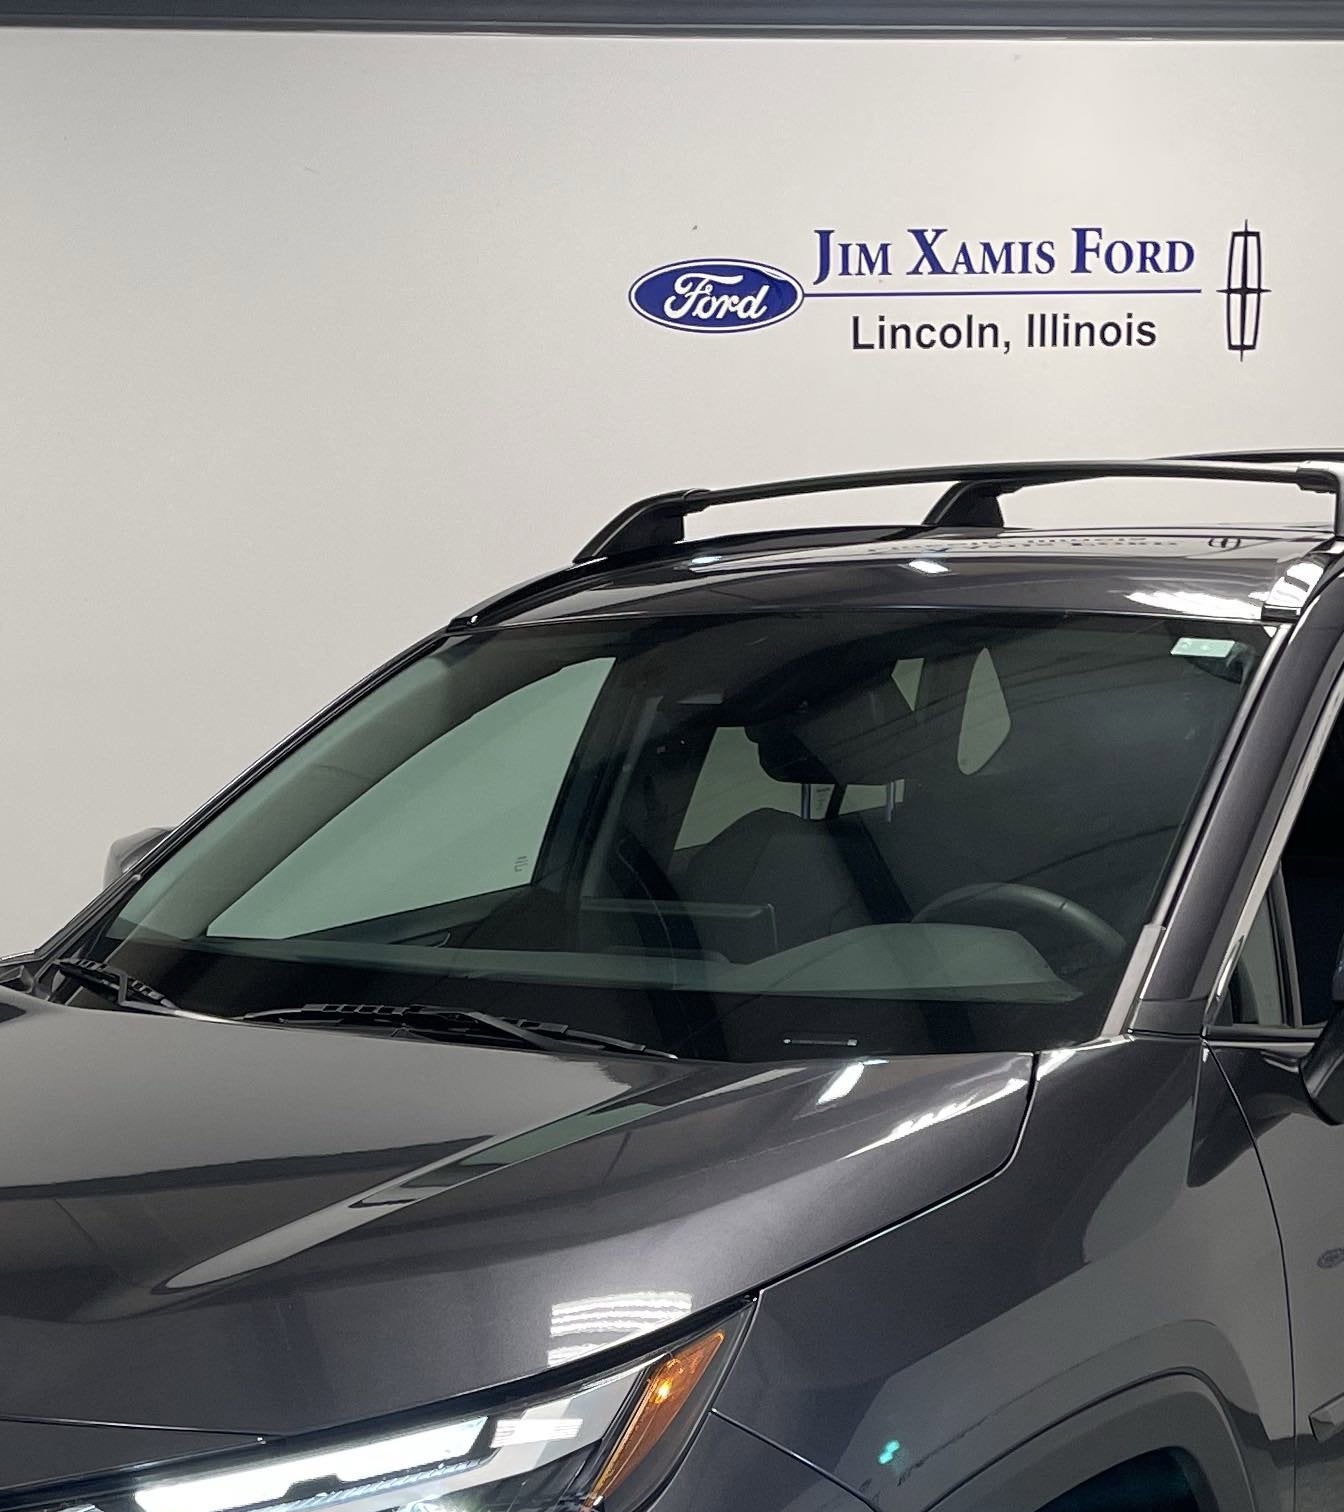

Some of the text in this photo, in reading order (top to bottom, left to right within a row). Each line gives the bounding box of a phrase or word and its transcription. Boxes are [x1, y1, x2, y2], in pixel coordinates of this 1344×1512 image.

[813, 228, 1194, 285] JIM XAMIS FORD
[664, 273, 769, 321] Ford
[853, 313, 1156, 354] Lincoln, Illinois
